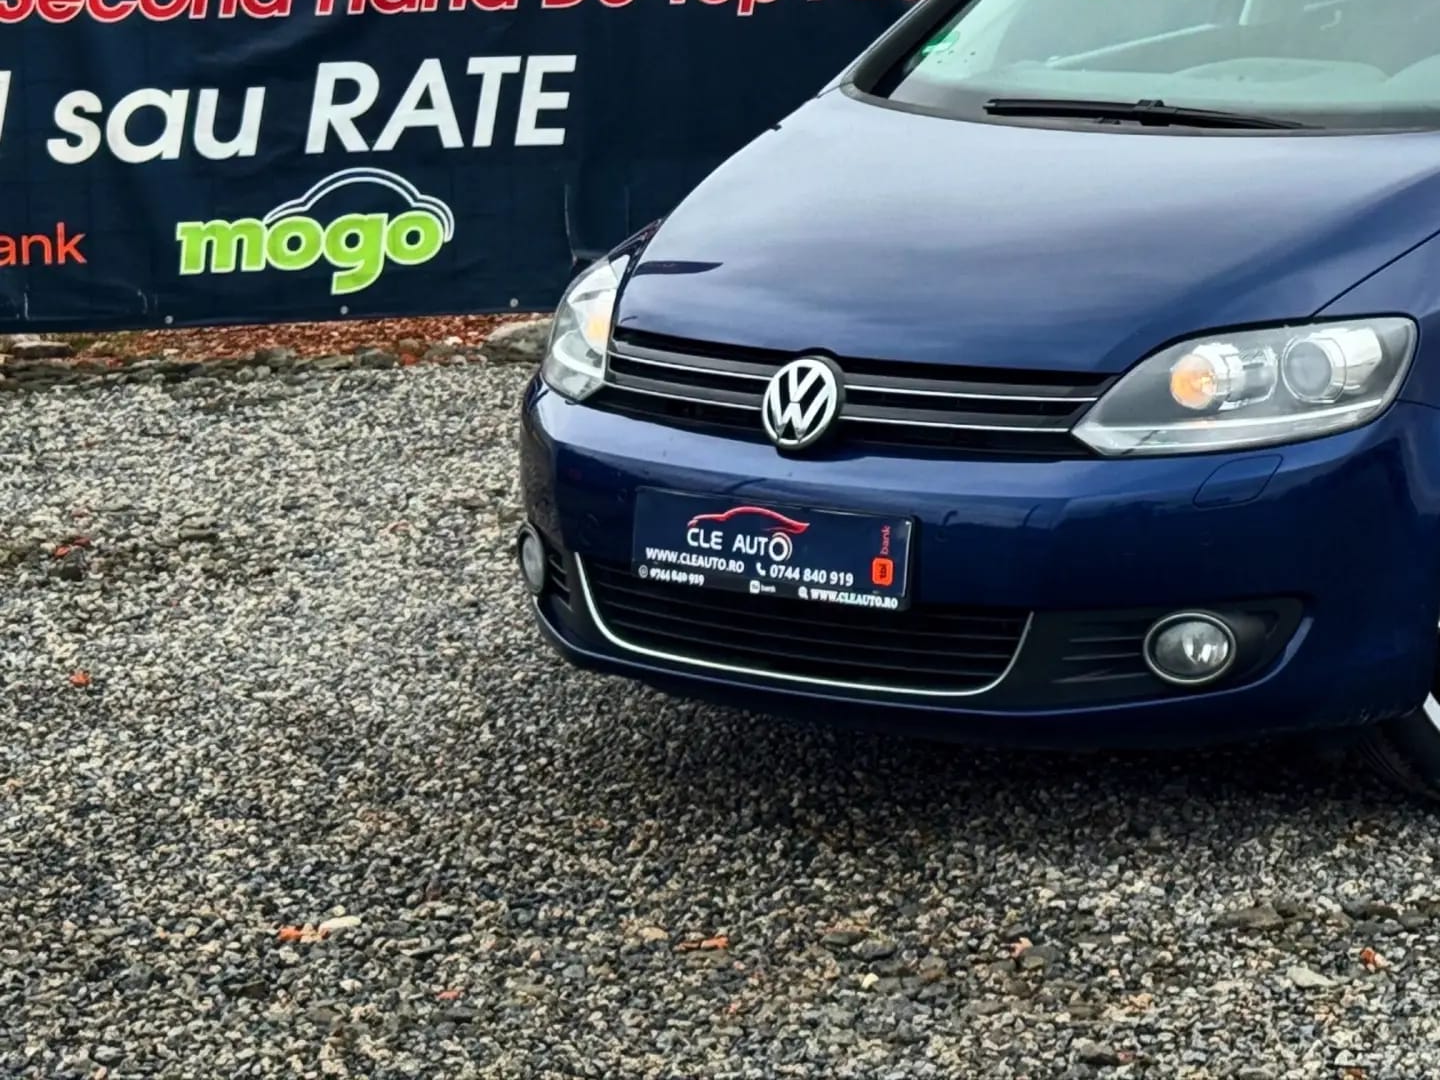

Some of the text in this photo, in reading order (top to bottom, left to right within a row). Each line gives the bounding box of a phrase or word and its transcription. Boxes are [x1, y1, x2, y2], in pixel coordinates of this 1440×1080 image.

[47, 88, 265, 163] sau
[305, 54, 577, 155] RATE
[0, 222, 87, 265] ank
[177, 210, 446, 295] mogo
[645, 547, 745, 573] WWW.CLEAUTO.RO
[687, 527, 789, 562] CLE AUTO
[769, 564, 854, 587] 0744 840 919
[810, 588, 899, 610] WWW.CLEAUTO.RO
